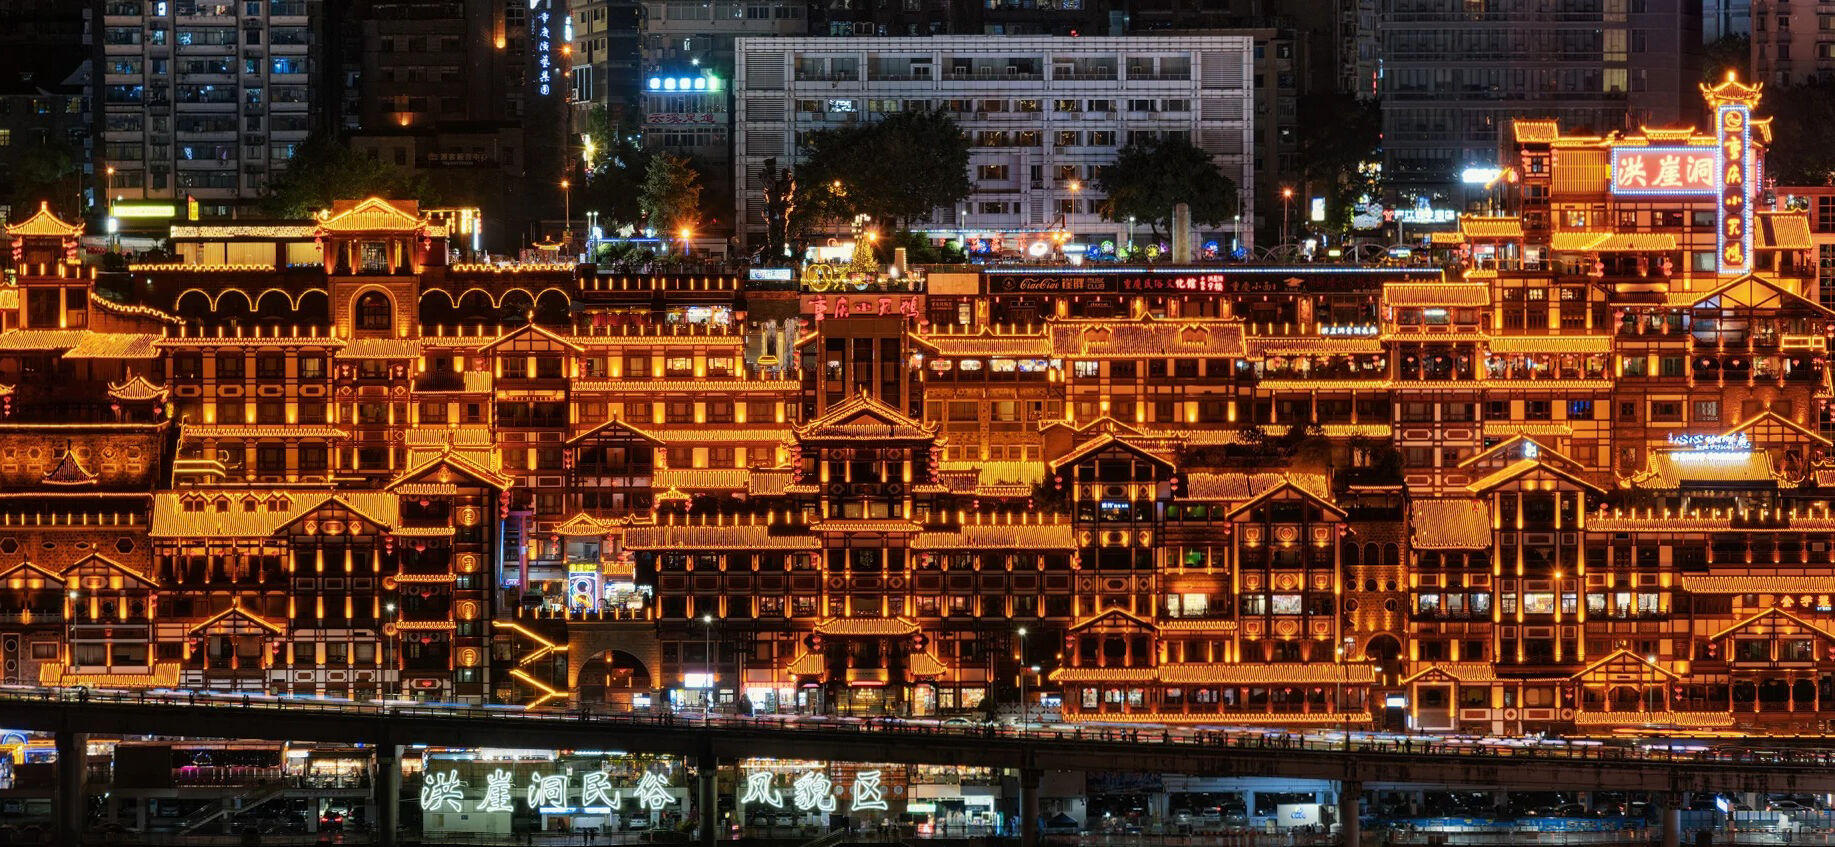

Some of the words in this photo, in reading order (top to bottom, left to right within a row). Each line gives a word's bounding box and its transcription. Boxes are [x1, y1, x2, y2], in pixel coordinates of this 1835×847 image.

[1617, 154, 1714, 187] 洪崖洞
[421, 769, 675, 812] 洪崖洞民俗
[741, 771, 888, 811] 风貌区
